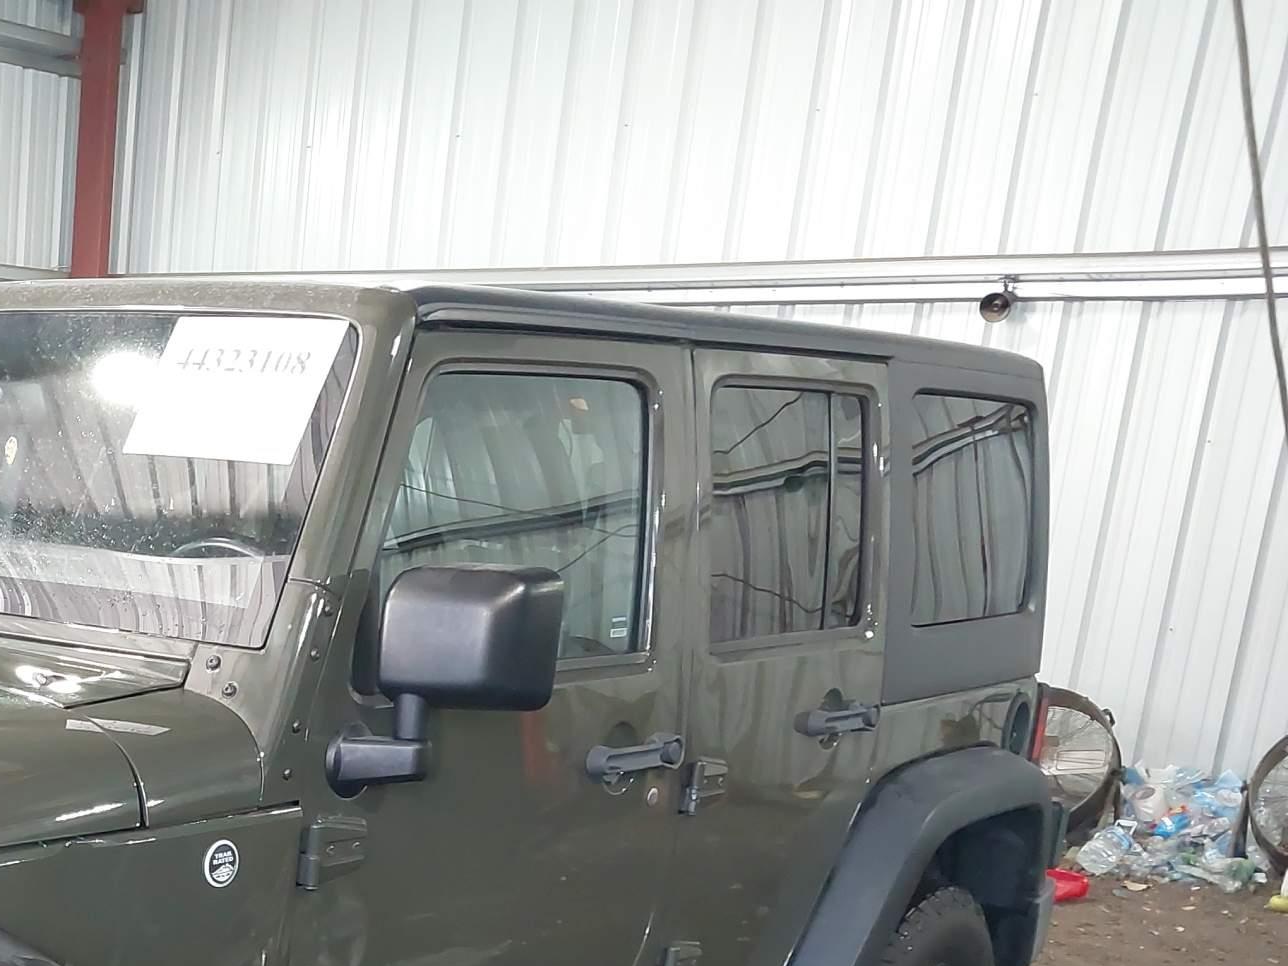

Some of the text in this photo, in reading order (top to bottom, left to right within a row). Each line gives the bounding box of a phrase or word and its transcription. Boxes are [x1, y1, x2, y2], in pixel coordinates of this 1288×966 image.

[177, 348, 311, 375] 44323108
[214, 850, 232, 859] TRAIL
[212, 856, 234, 865] RATED
